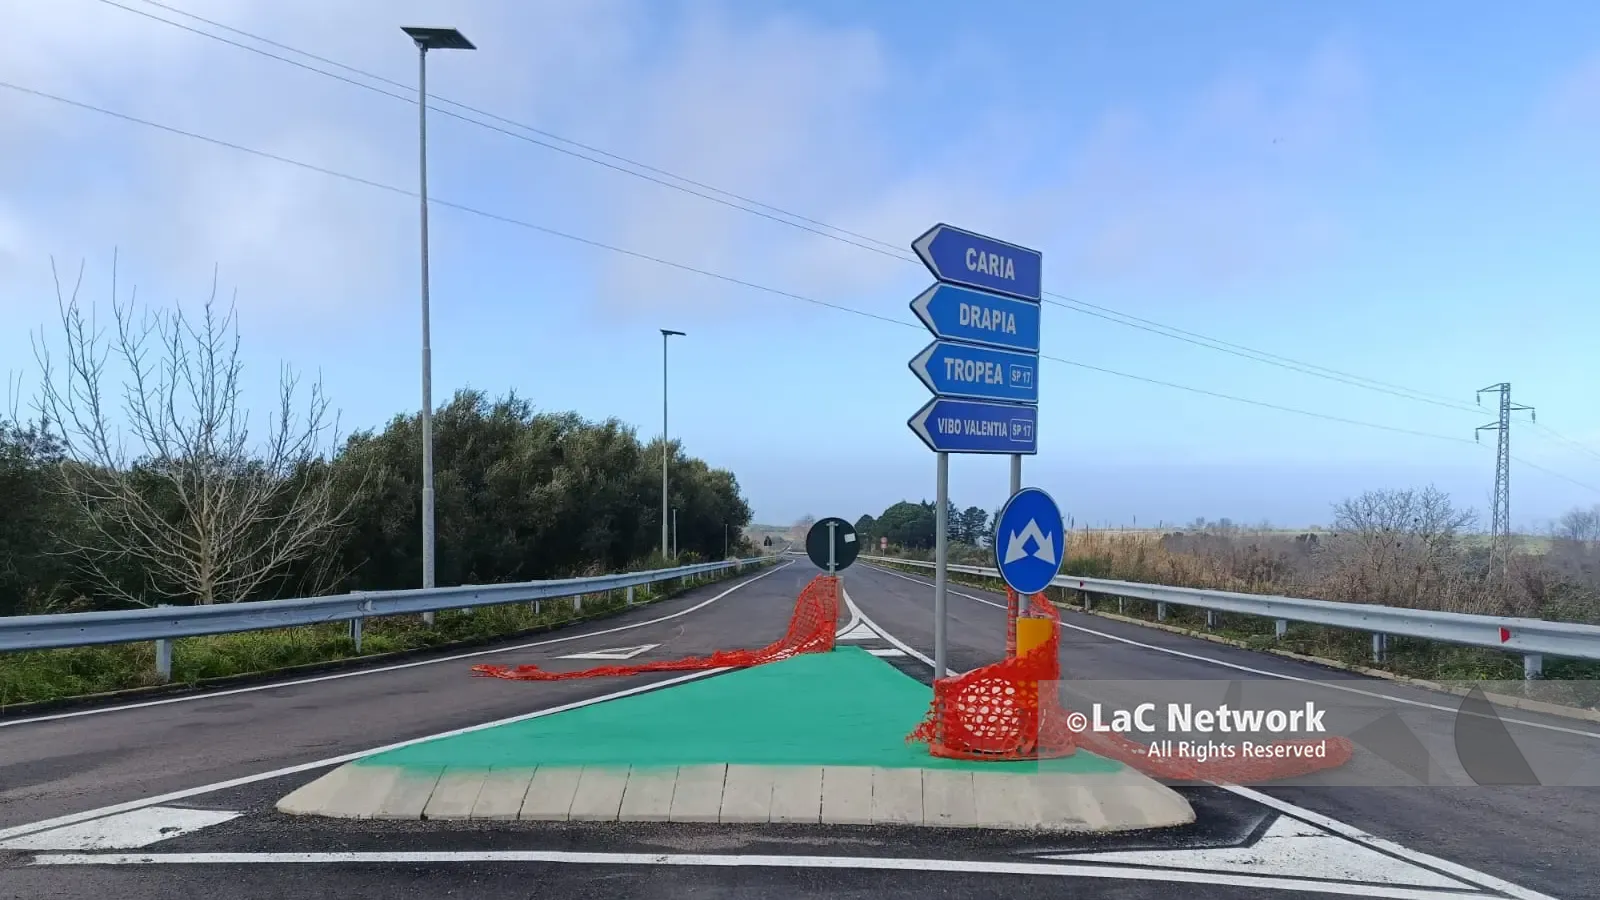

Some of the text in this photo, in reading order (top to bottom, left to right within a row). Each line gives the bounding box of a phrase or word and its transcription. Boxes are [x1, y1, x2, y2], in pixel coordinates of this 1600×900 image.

[966, 247, 1015, 280] CARIA
[960, 302, 1016, 334] DRAPIA
[944, 357, 1031, 384] TROPEA SP 17
[937, 417, 1032, 437] VIBO VALENTIA SP 17
